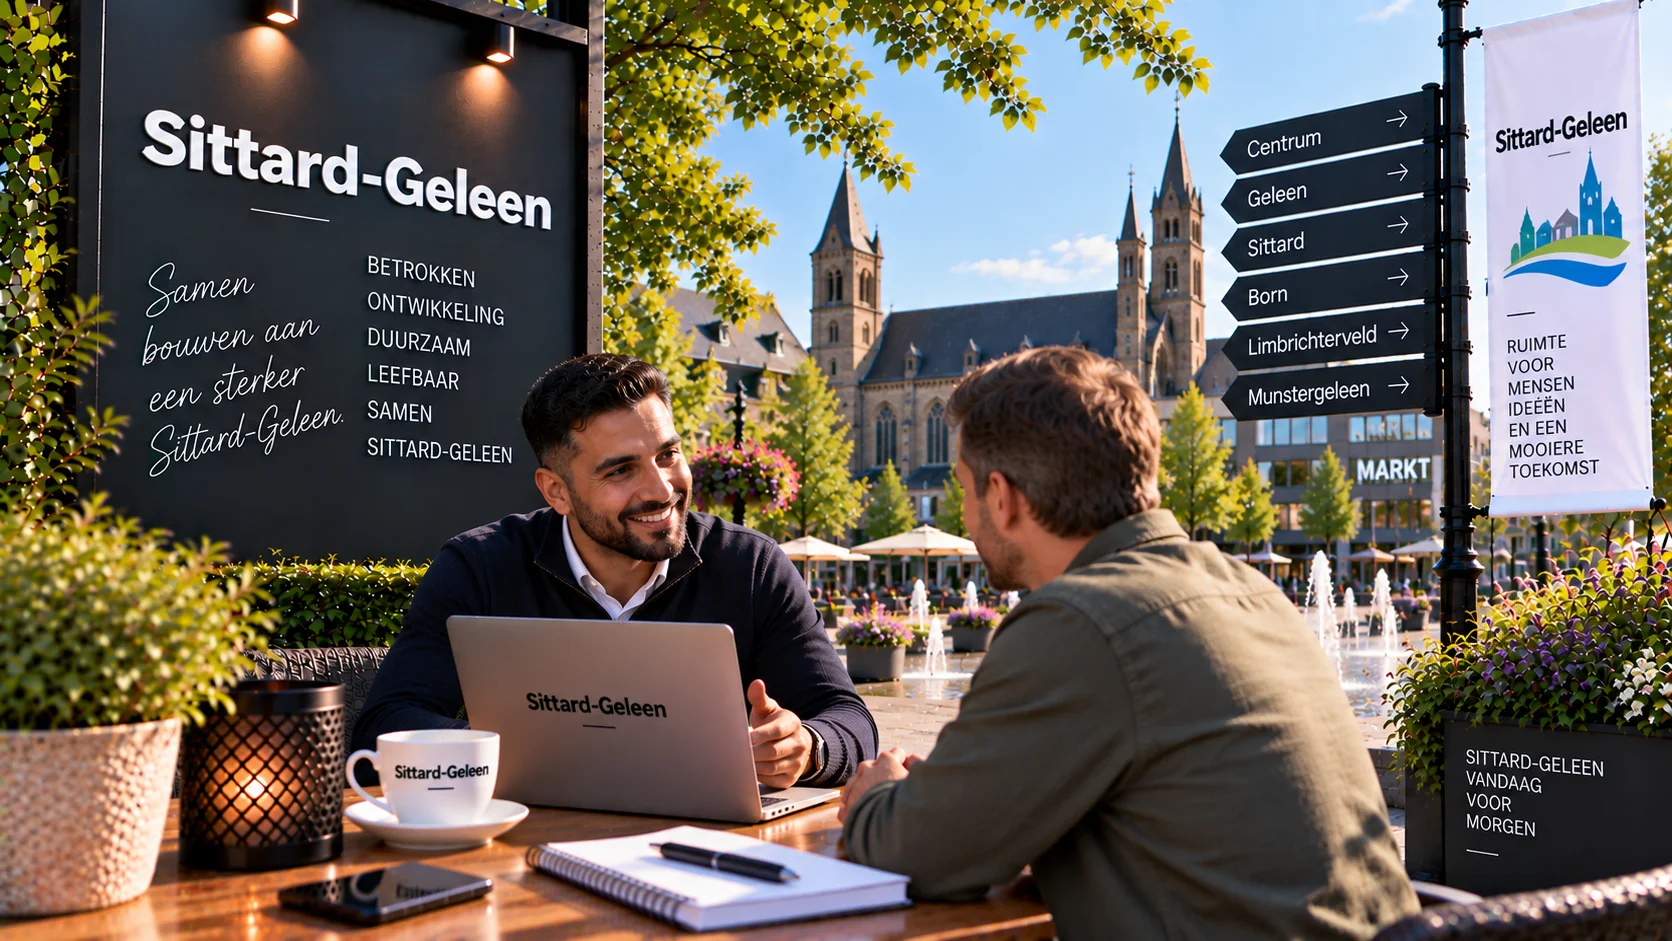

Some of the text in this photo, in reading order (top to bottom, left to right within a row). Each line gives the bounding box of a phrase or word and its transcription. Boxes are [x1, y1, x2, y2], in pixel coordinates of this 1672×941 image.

[1495, 110, 1628, 153] Sittard-Geleen
[1247, 132, 1321, 158] Centrum
[141, 109, 552, 230] Sittard-Geleen
[1247, 185, 1307, 208] Geleen
[1248, 232, 1305, 257] Sittard
[368, 255, 475, 288] BETROKKEN
[145, 262, 255, 318] Samen
[1248, 288, 1288, 306] Born
[367, 291, 505, 326] ONTWIKKELING
[141, 319, 320, 366] bouwen aan
[368, 327, 470, 357] DUURZAAM
[1248, 325, 1377, 356] Limbrichterveld
[1507, 333, 1567, 354] RUIMTE
[368, 363, 459, 391] LEEFBAAR
[1507, 356, 1554, 375] VOOR
[149, 354, 306, 413] een sterker
[1248, 380, 1370, 406] Munstergeleen
[1508, 375, 1575, 396] MENSEN
[367, 399, 432, 423] SAMEN
[149, 399, 344, 478] Sittard-Geleen.
[1509, 418, 1567, 438] EN EEN
[367, 437, 512, 464] SITTARD-GELEEN
[1509, 439, 1584, 459] MOOIERE
[1357, 457, 1431, 484] MARKT
[1509, 459, 1600, 479] TOEKOMST
[525, 692, 668, 718] Sittard-Geleen
[394, 763, 489, 780] Sittard-Geleen
[1466, 749, 1604, 777] SITTARD-GELEEN
[1465, 770, 1542, 794] VANDAAG
[1466, 792, 1512, 813] VOOR
[1466, 813, 1536, 837] MORGEN
